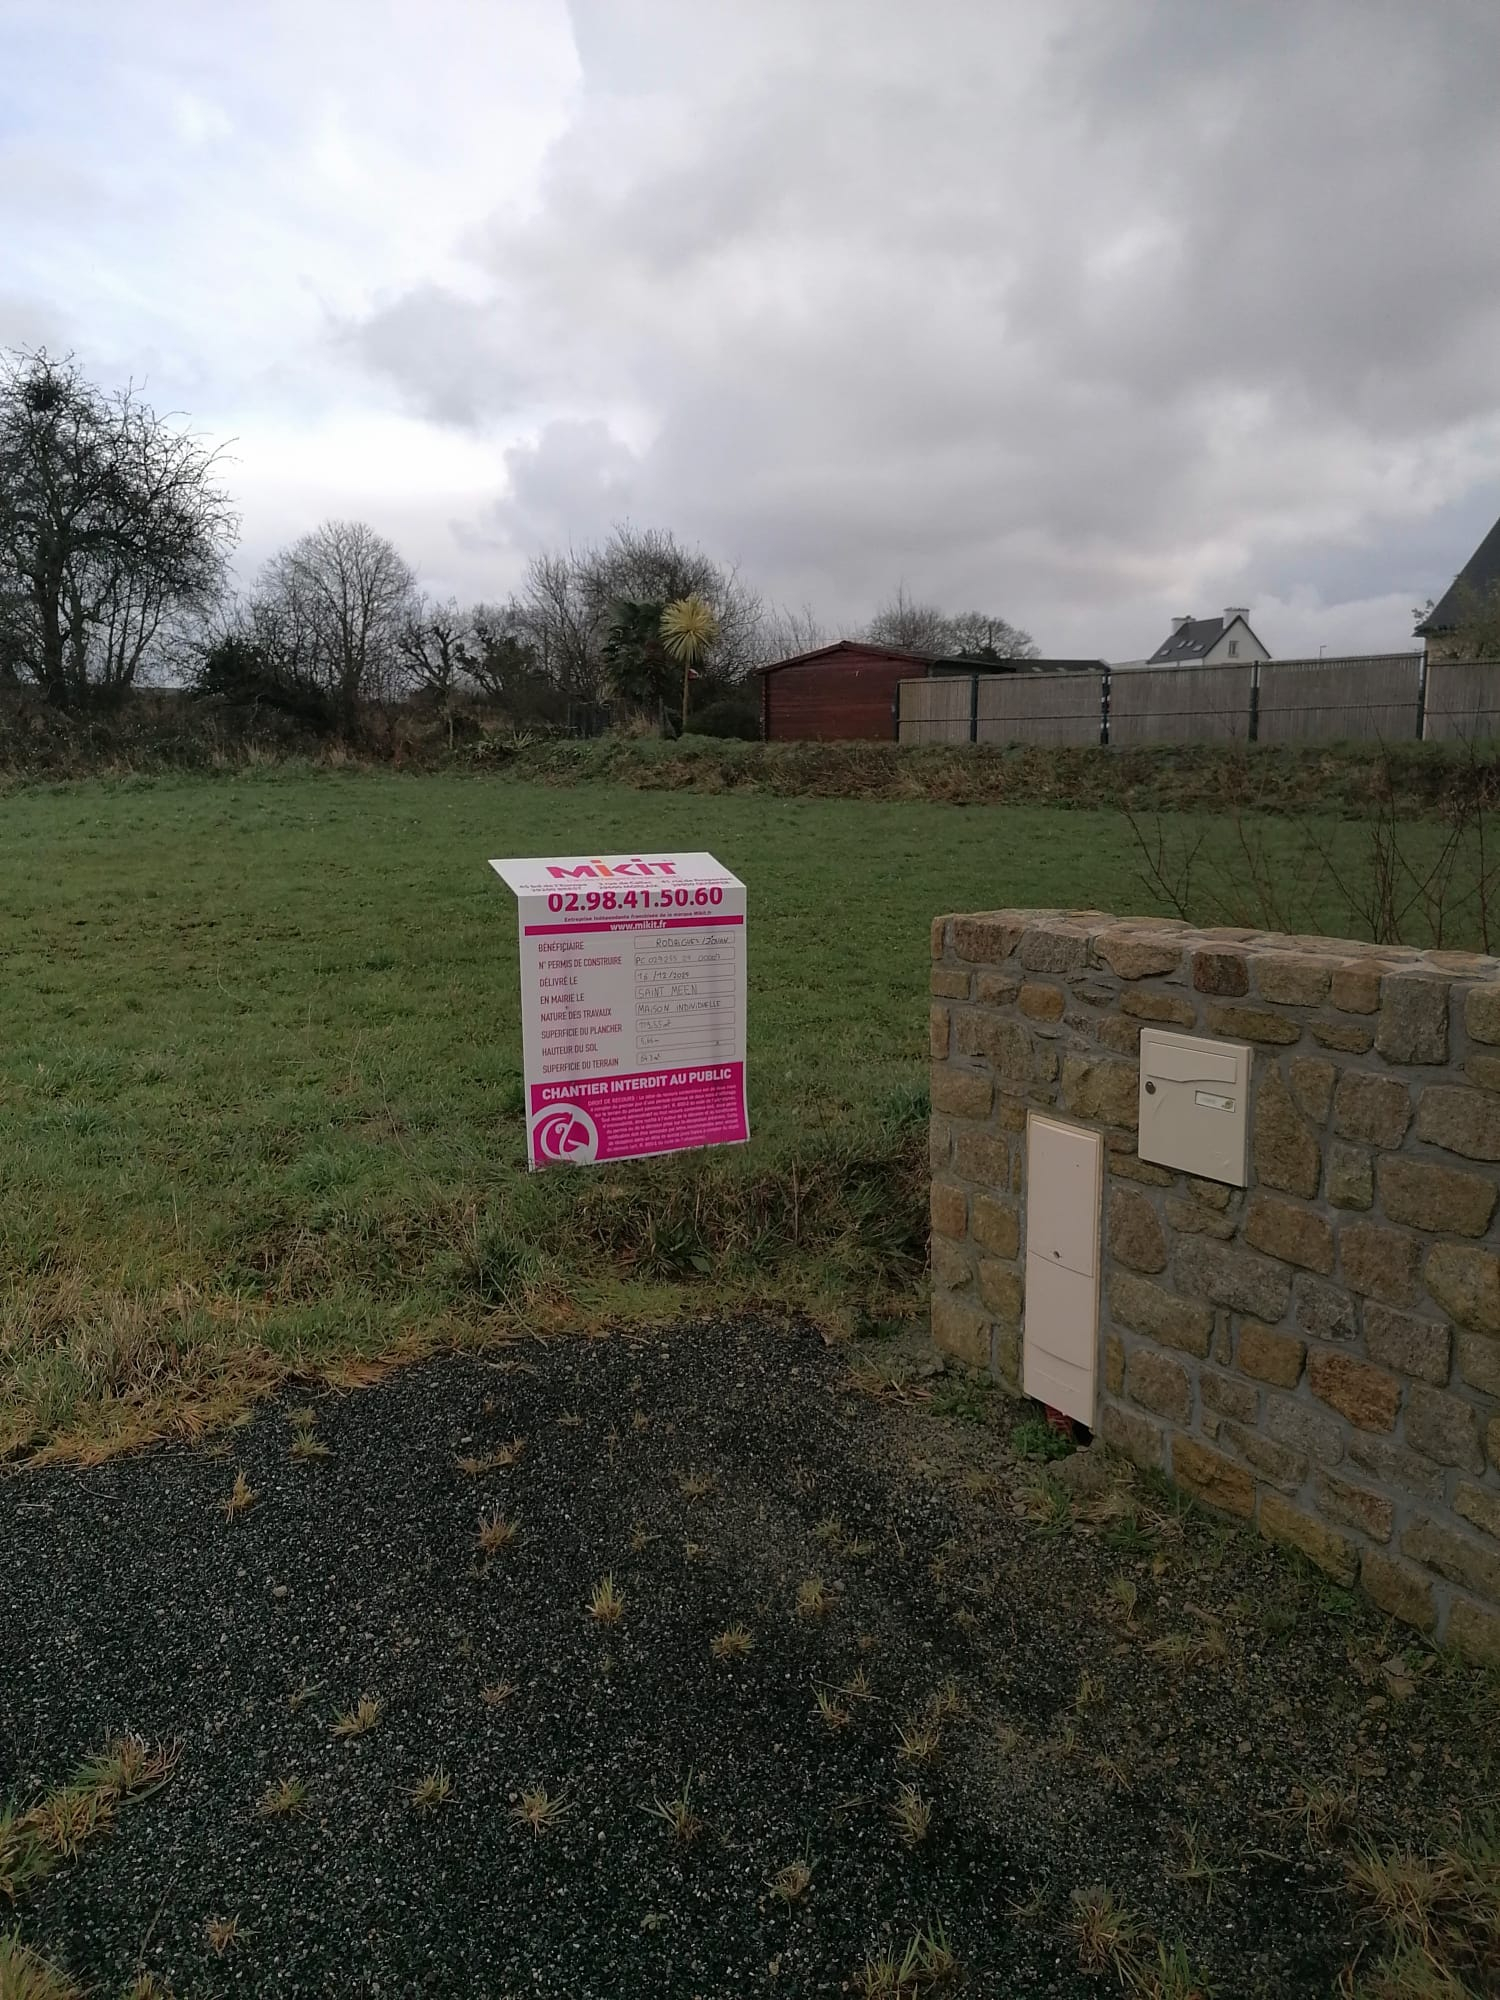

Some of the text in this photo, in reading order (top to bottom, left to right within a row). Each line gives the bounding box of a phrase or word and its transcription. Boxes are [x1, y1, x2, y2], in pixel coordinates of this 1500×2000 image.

[547, 887, 723, 912] 02.98.41.50.60
[609, 919, 667, 931] www.mikit.fr
[538, 940, 584, 952] BÉNÉFICIAIRE
[548, 959, 572, 969] PERMIS
[574, 958, 582, 968] DE
[583, 956, 622, 967] CONSTRUIRE
[540, 976, 578, 987] DÉLIVRÉ LE
[540, 992, 585, 1005] EN MAIRIE LE
[638, 986, 664, 999] SAINT
[541, 1007, 611, 1022] NATURE DES TRAVAUX
[636, 1002, 669, 1016] MAISON
[541, 1023, 623, 1040] SUPERFICIE DU PLANCHER
[542, 1043, 598, 1057] HAUTEUR DU SOL
[542, 1057, 619, 1074] SUPERFICIE DU TERRAIN
[542, 1068, 732, 1100] CHANTIER INTERDIT AU PUBLIC
